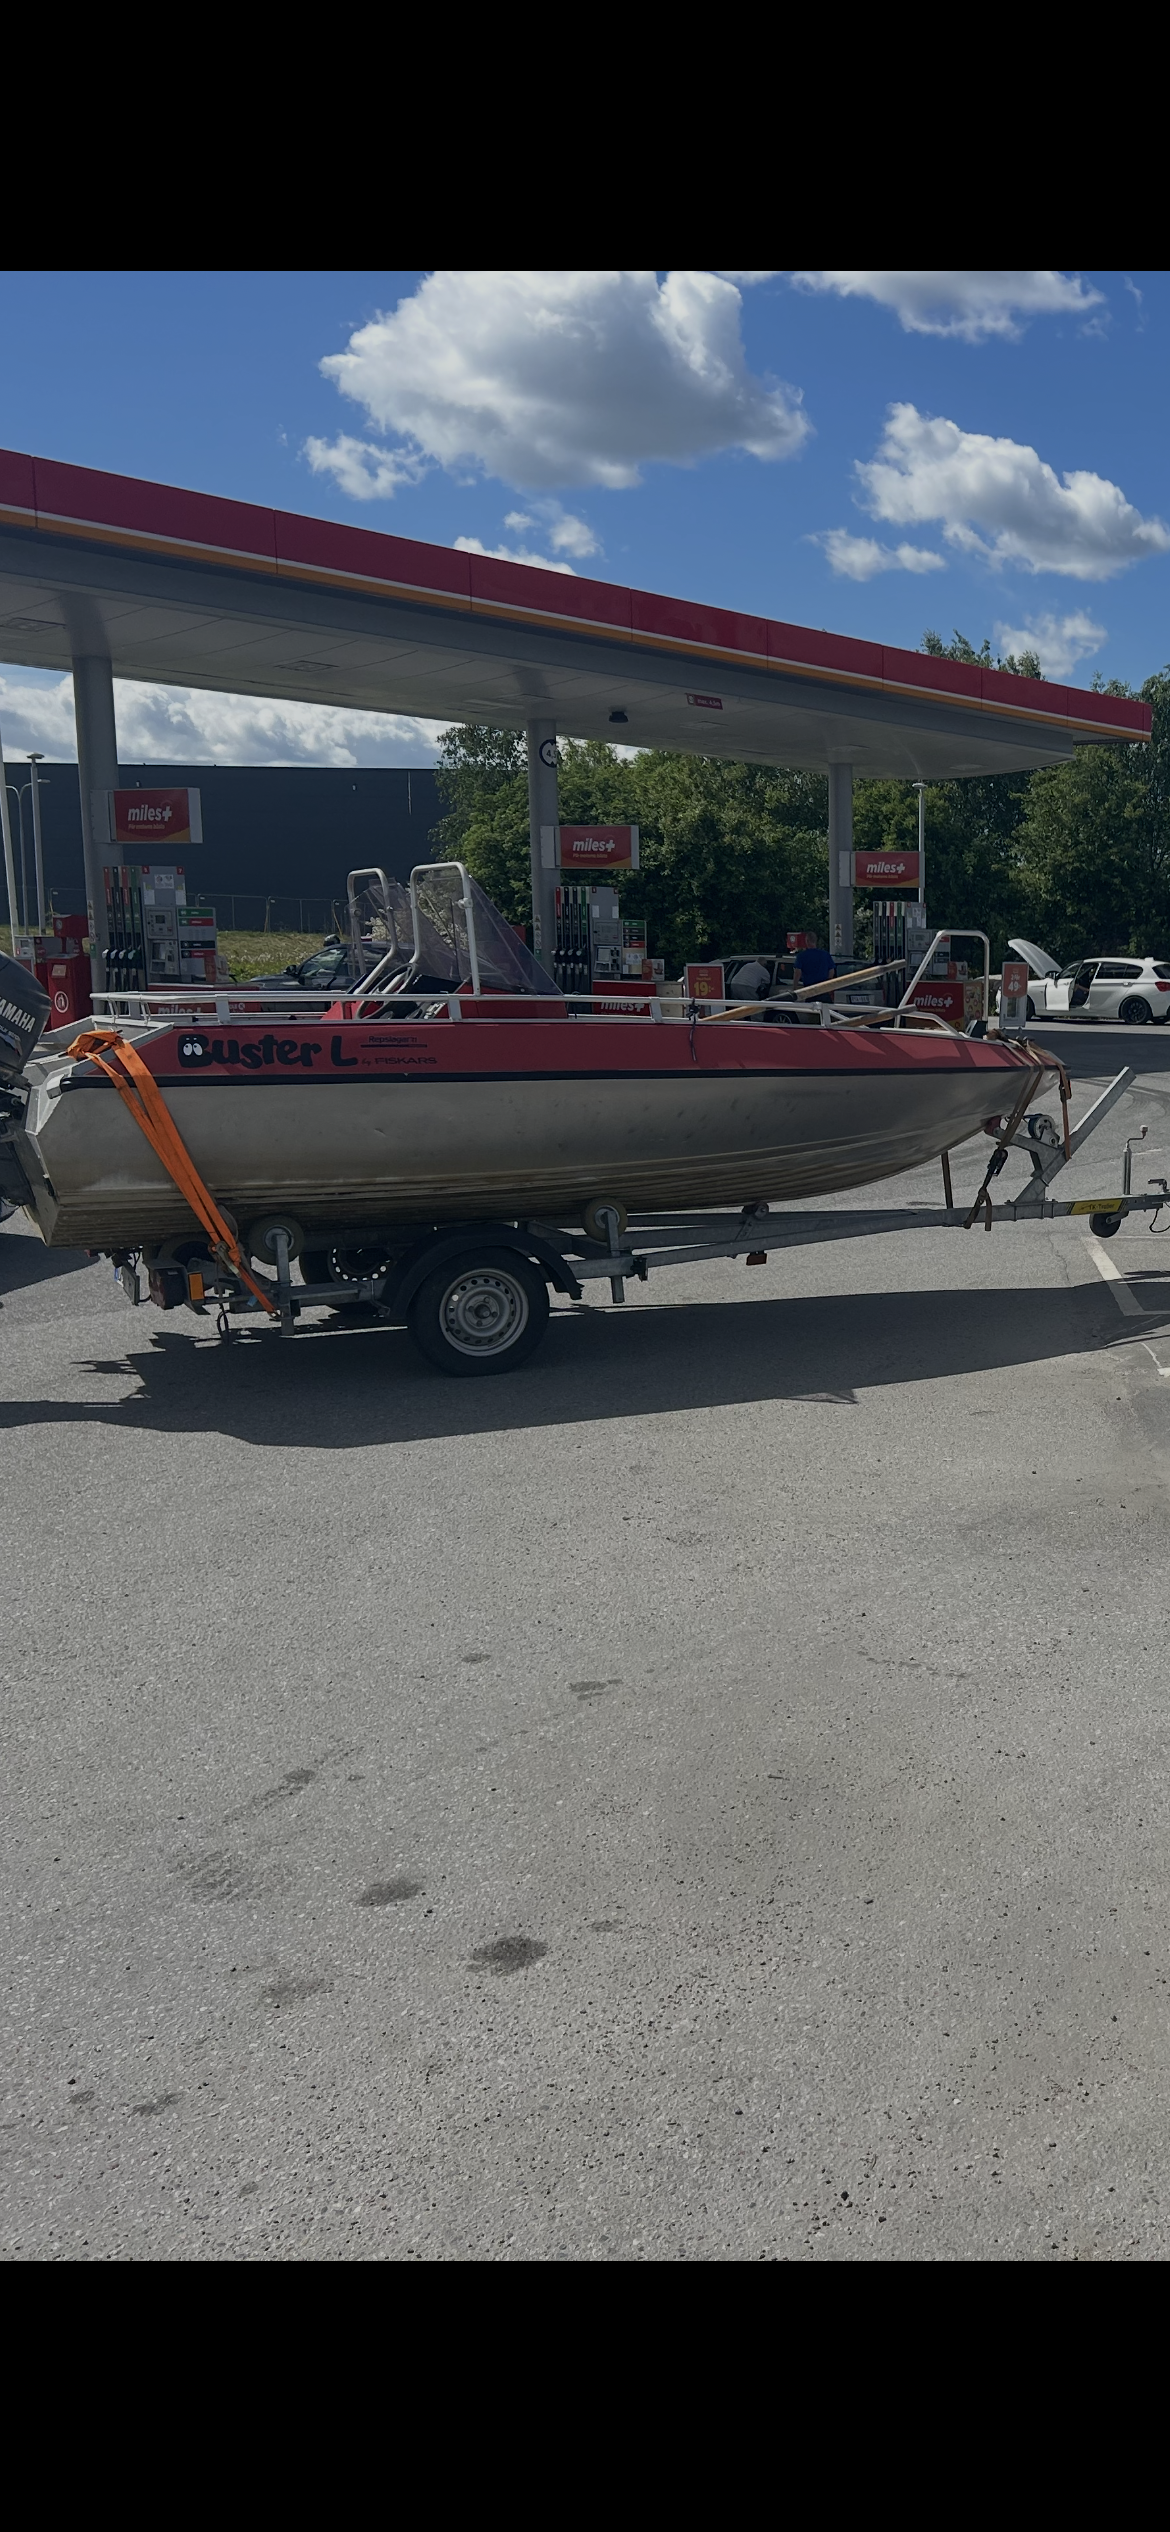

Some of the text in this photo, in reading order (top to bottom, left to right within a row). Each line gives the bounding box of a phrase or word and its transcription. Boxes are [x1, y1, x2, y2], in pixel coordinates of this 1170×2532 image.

[128, 804, 173, 822] miles+
[572, 837, 616, 853] miles+
[867, 861, 906, 874] miles+
[913, 995, 953, 1008] miles+
[0, 997, 36, 1033] AMAHA
[178, 1034, 359, 1069] Buster L
[375, 1057, 438, 1065] FISKARS
